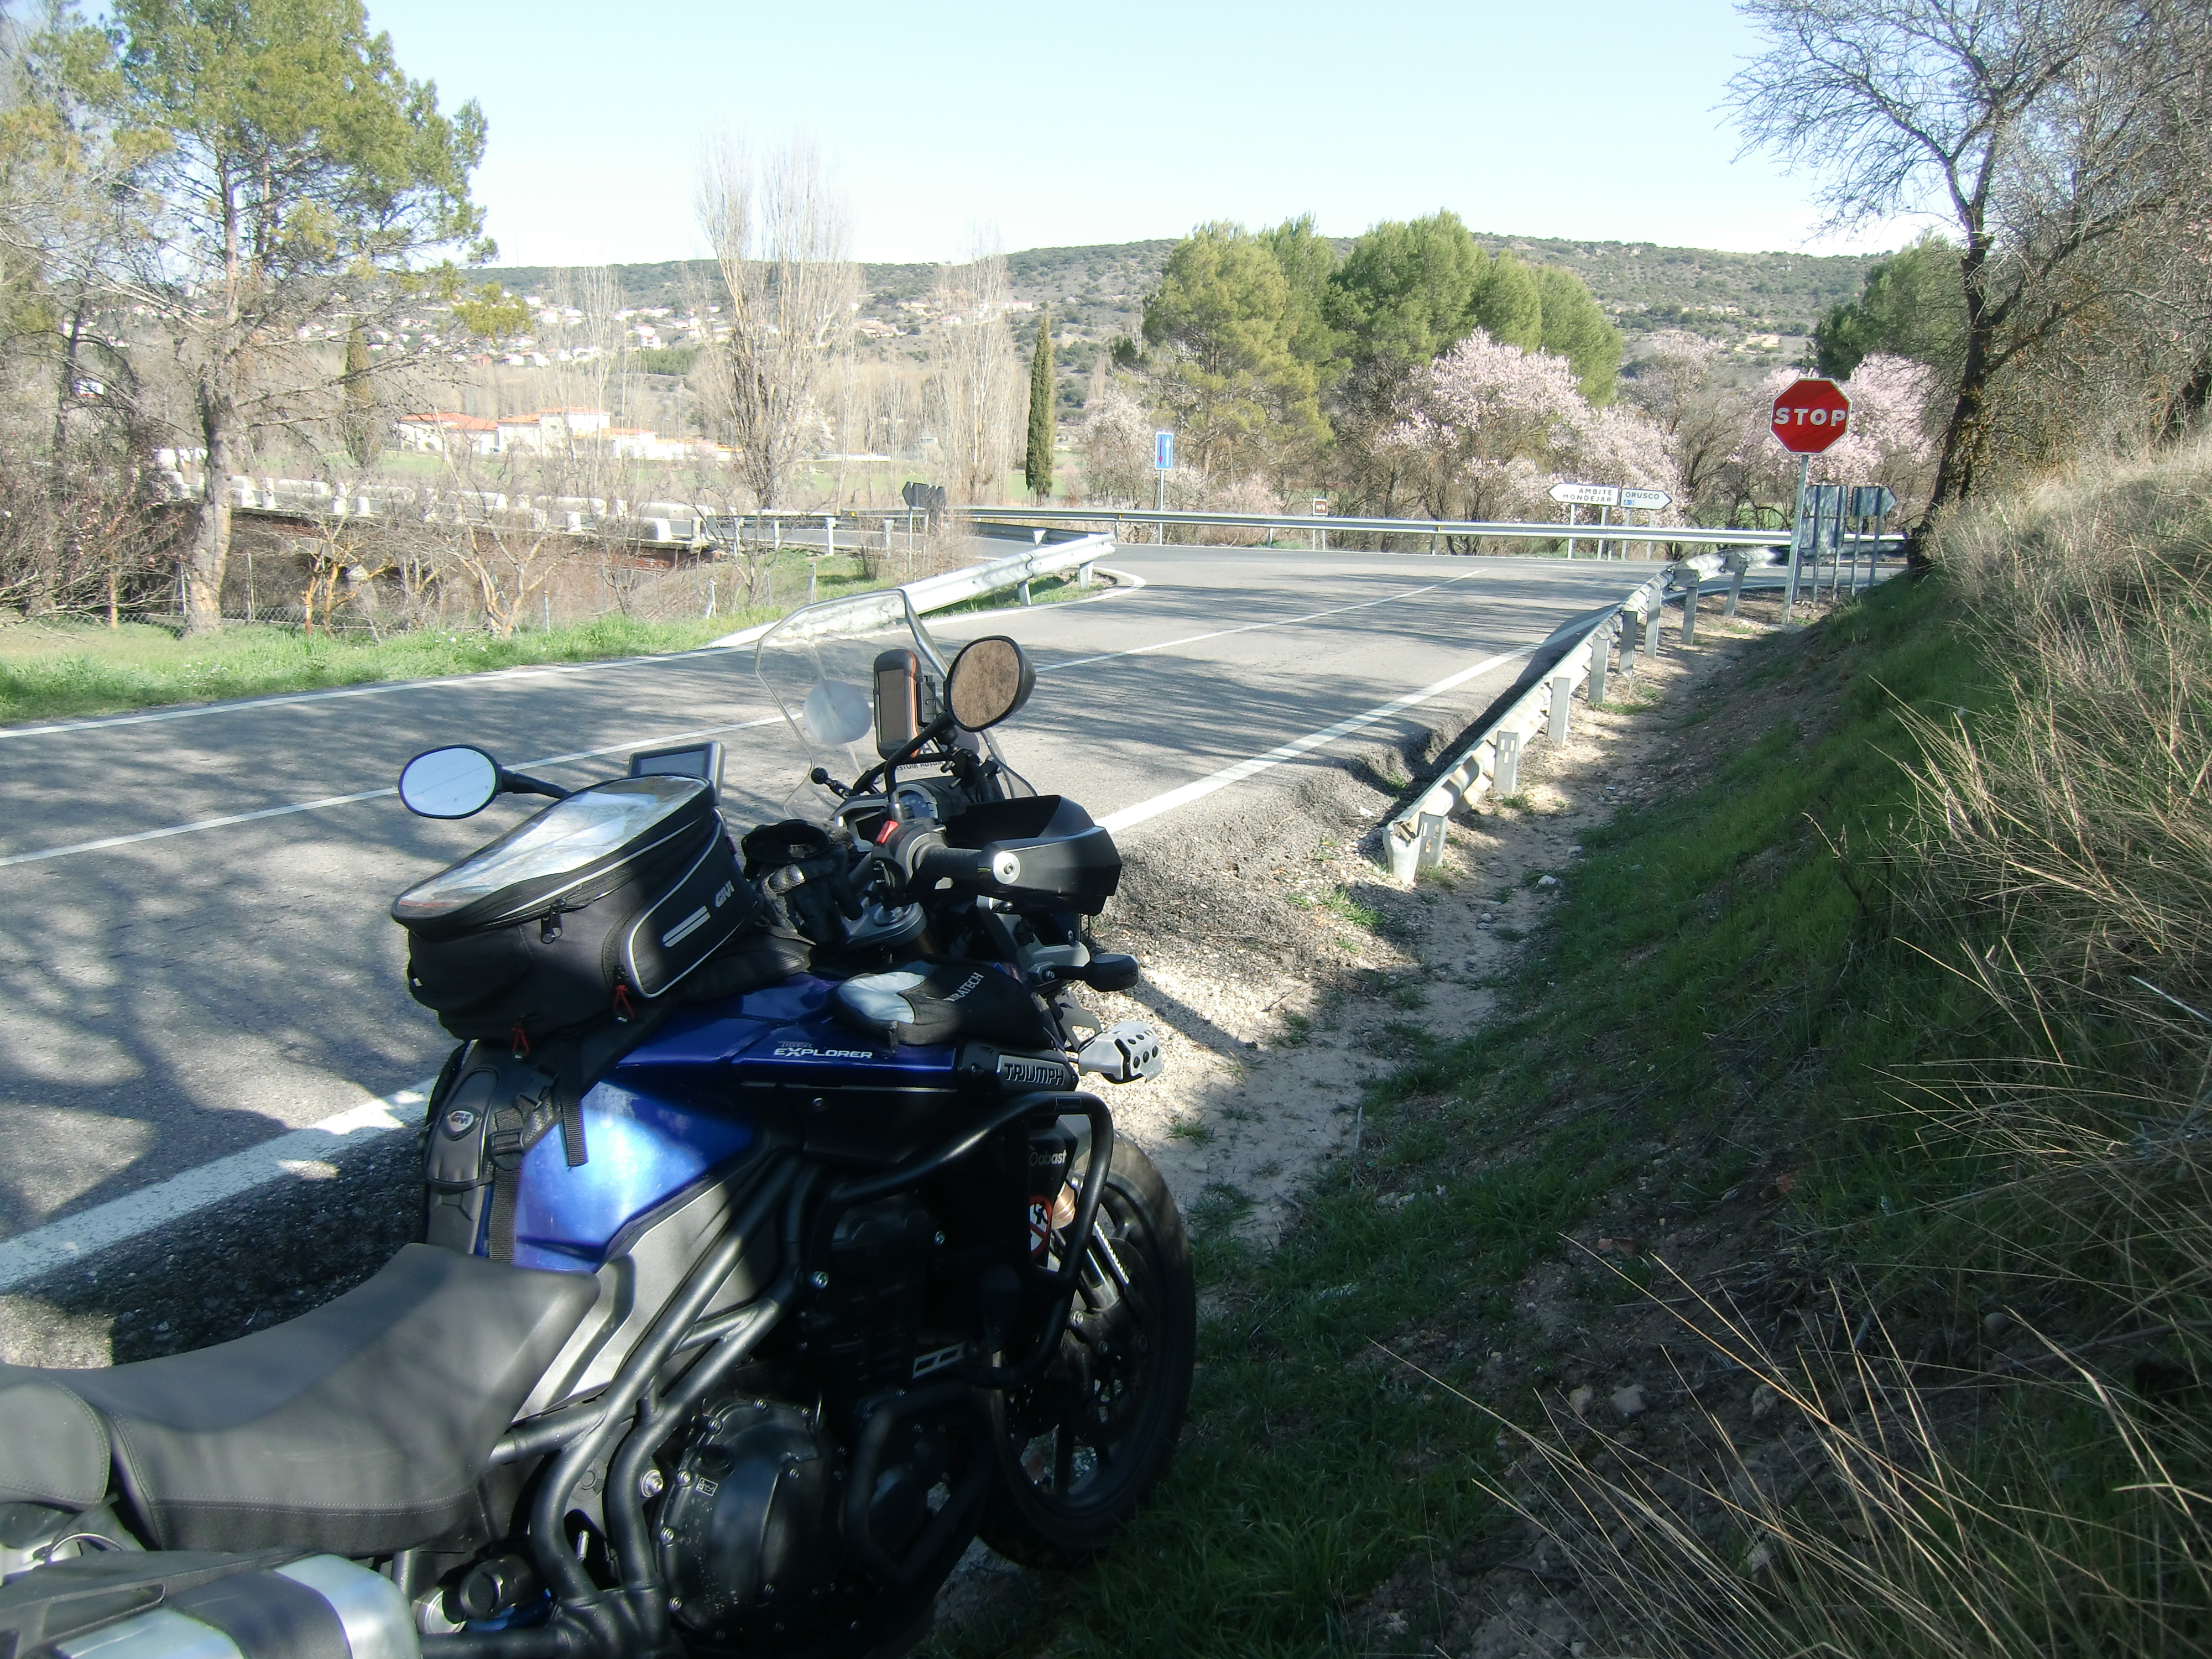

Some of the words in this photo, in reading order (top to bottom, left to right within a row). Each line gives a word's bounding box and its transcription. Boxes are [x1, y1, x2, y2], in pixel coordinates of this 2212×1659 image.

[1773, 407, 1846, 426] STOP
[1563, 494, 1611, 502] MONDEJAR
[1625, 492, 1660, 500] ORUSCO
[774, 1047, 873, 1058] EXPLORER
[1004, 1063, 1065, 1086] TRIUMPH
